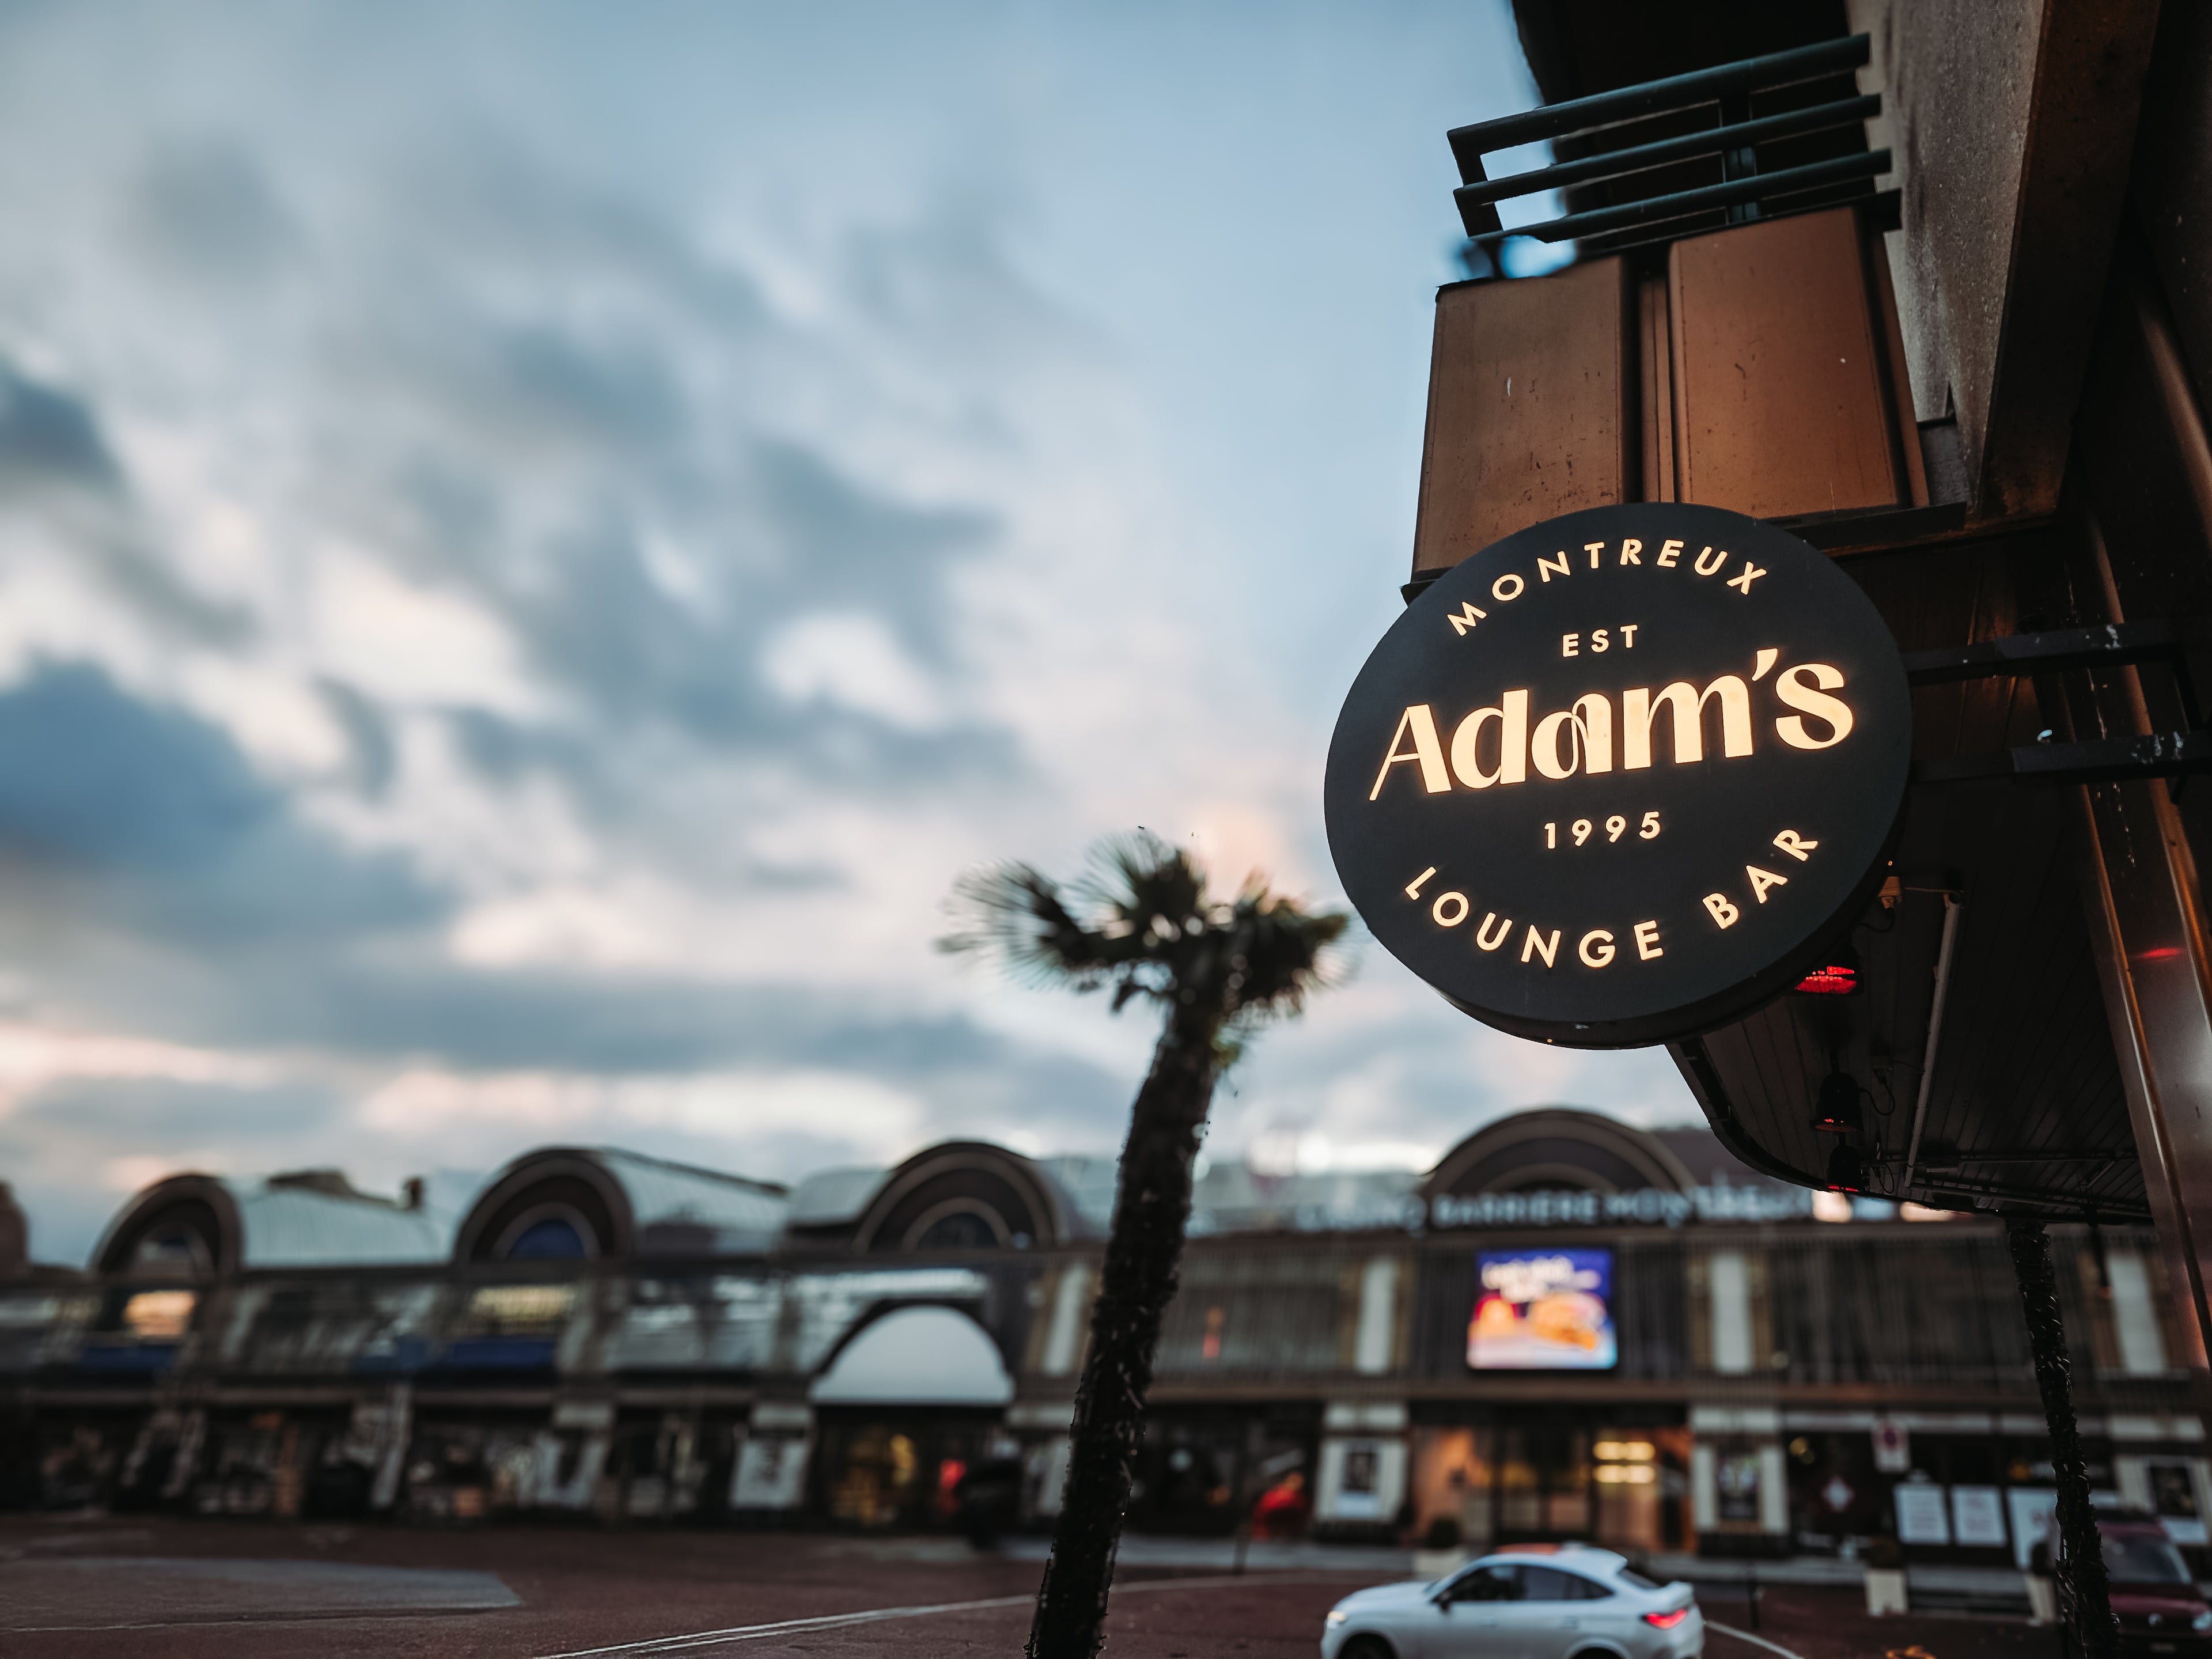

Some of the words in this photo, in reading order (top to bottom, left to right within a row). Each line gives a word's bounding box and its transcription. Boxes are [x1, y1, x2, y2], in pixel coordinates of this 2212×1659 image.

[1446, 538, 1767, 637] MONTREUX
[1562, 624, 1638, 658] EST
[1368, 647, 1854, 801] Adam's
[1544, 810, 1661, 850] 1995
[1404, 866, 1664, 969] LOUNGE
[1702, 829, 1819, 930] BAR
